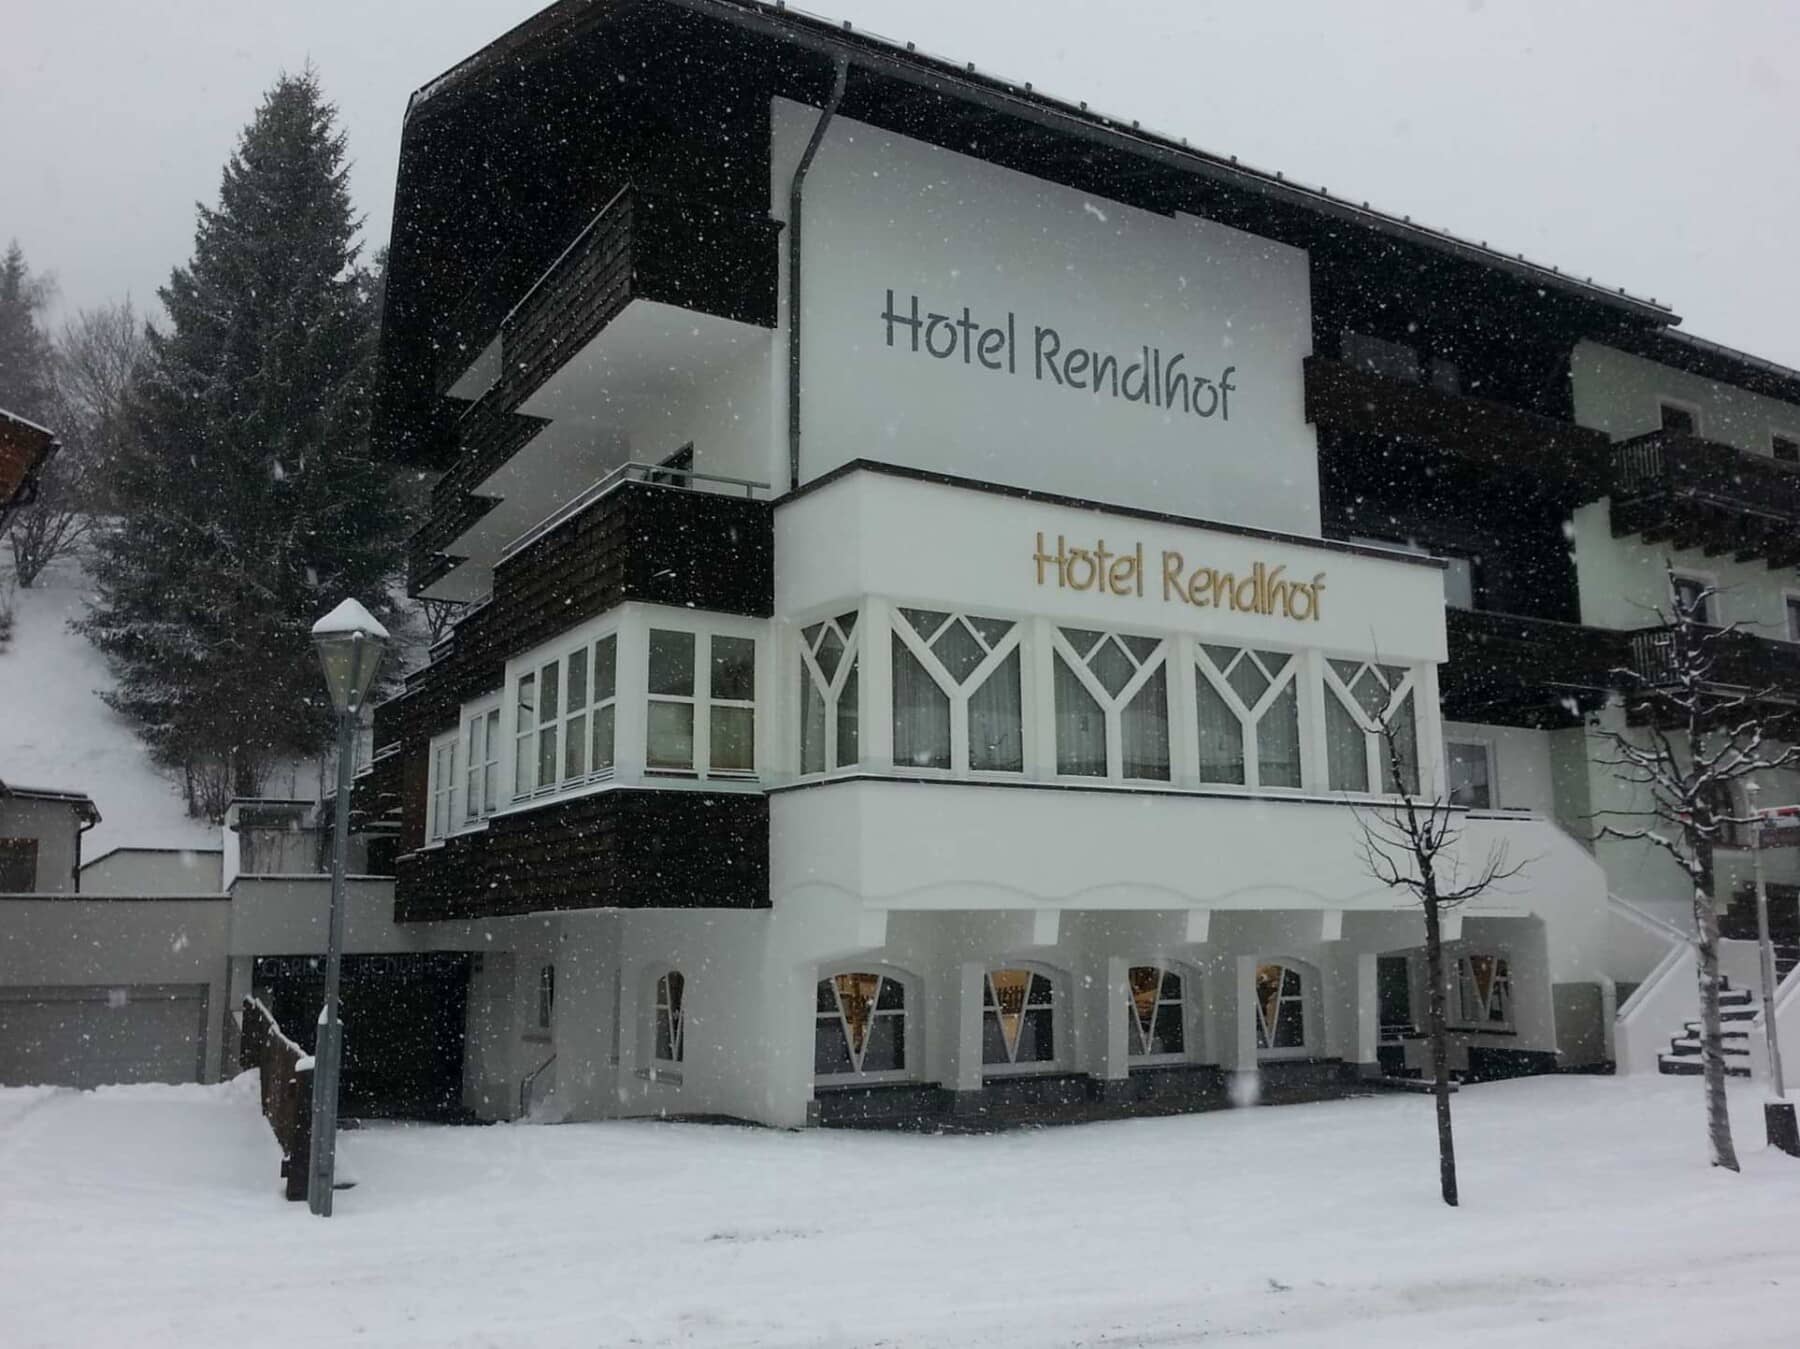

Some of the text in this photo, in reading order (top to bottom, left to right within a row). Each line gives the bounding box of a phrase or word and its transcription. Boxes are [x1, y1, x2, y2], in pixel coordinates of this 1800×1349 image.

[881, 289, 1236, 421] Hotel Rendlhof
[1033, 531, 1326, 621] Hotel Rendlhof
